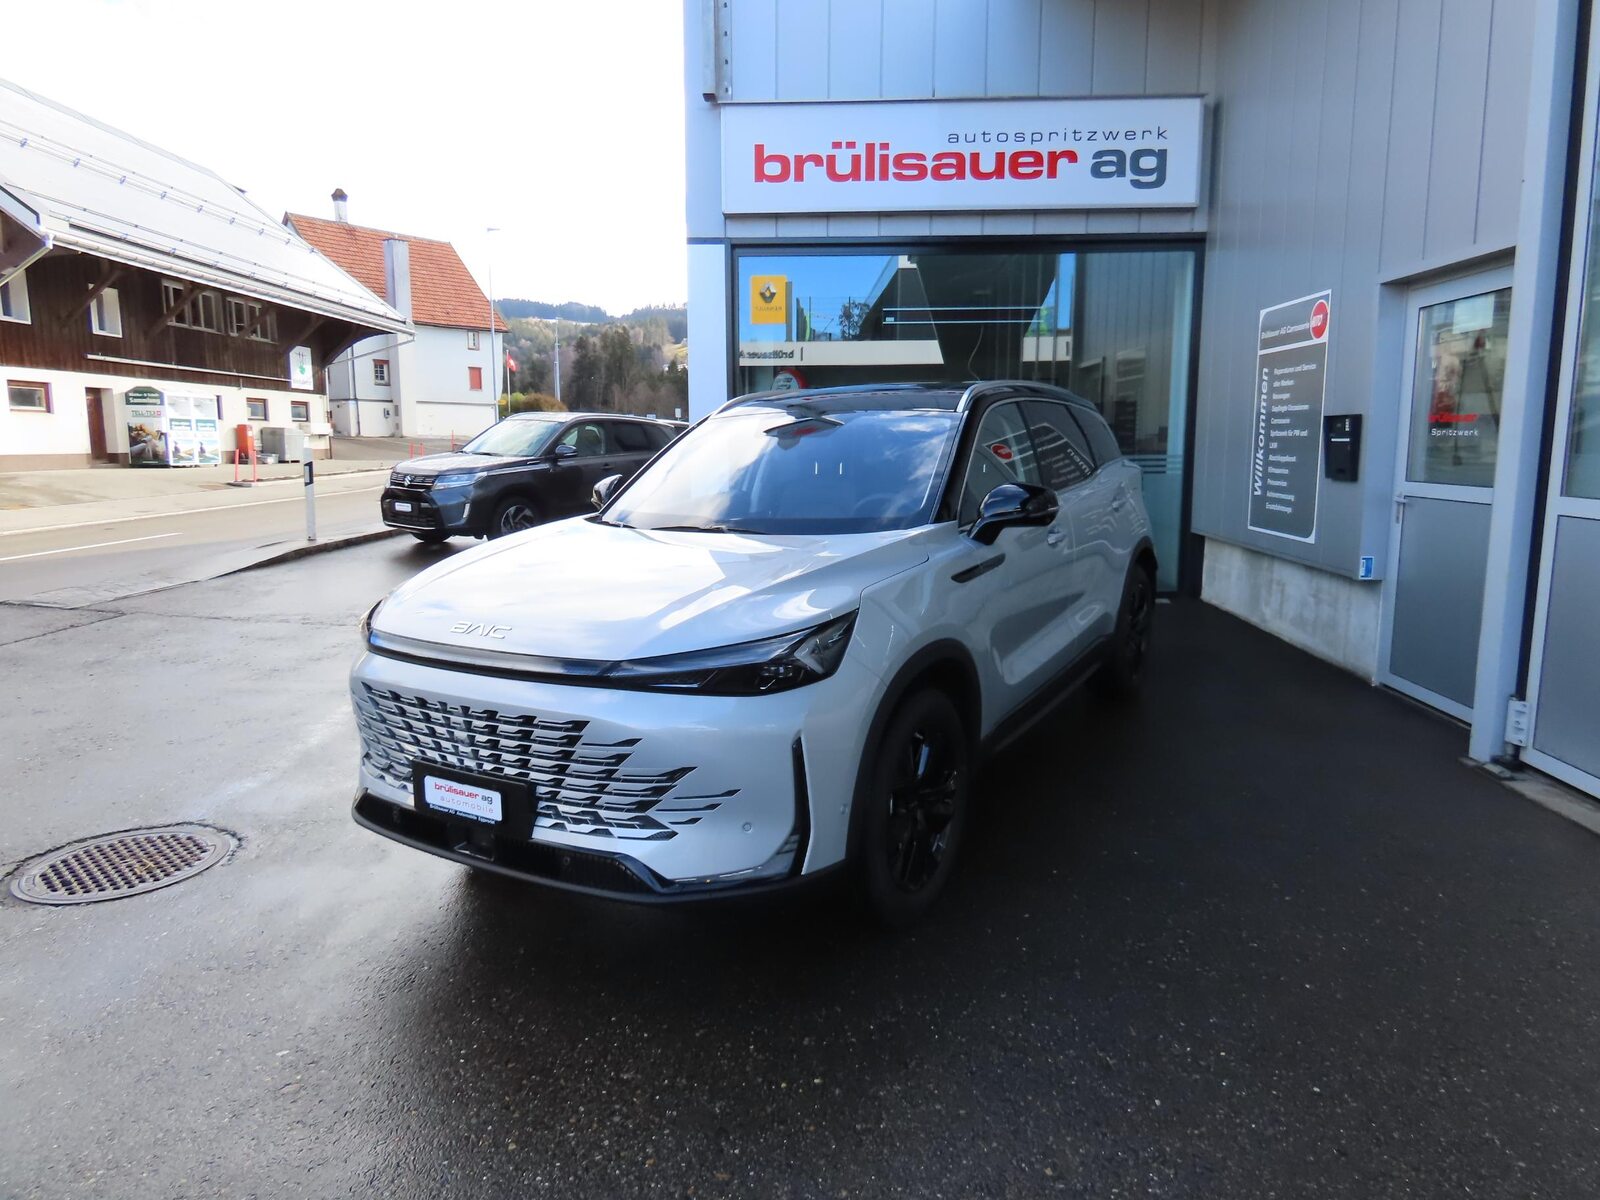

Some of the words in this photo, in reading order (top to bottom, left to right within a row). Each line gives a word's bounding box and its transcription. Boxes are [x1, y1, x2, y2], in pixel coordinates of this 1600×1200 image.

[947, 127, 1168, 145] autospritzwerk
[754, 141, 1078, 183] brülisauer
[1090, 148, 1168, 189] ag
[1254, 368, 1269, 495] Willkommen
[1432, 428, 1478, 436] Spritzwerk
[434, 782, 479, 799] brülisauer
[481, 794, 493, 805] ag
[440, 795, 494, 814] automobile
